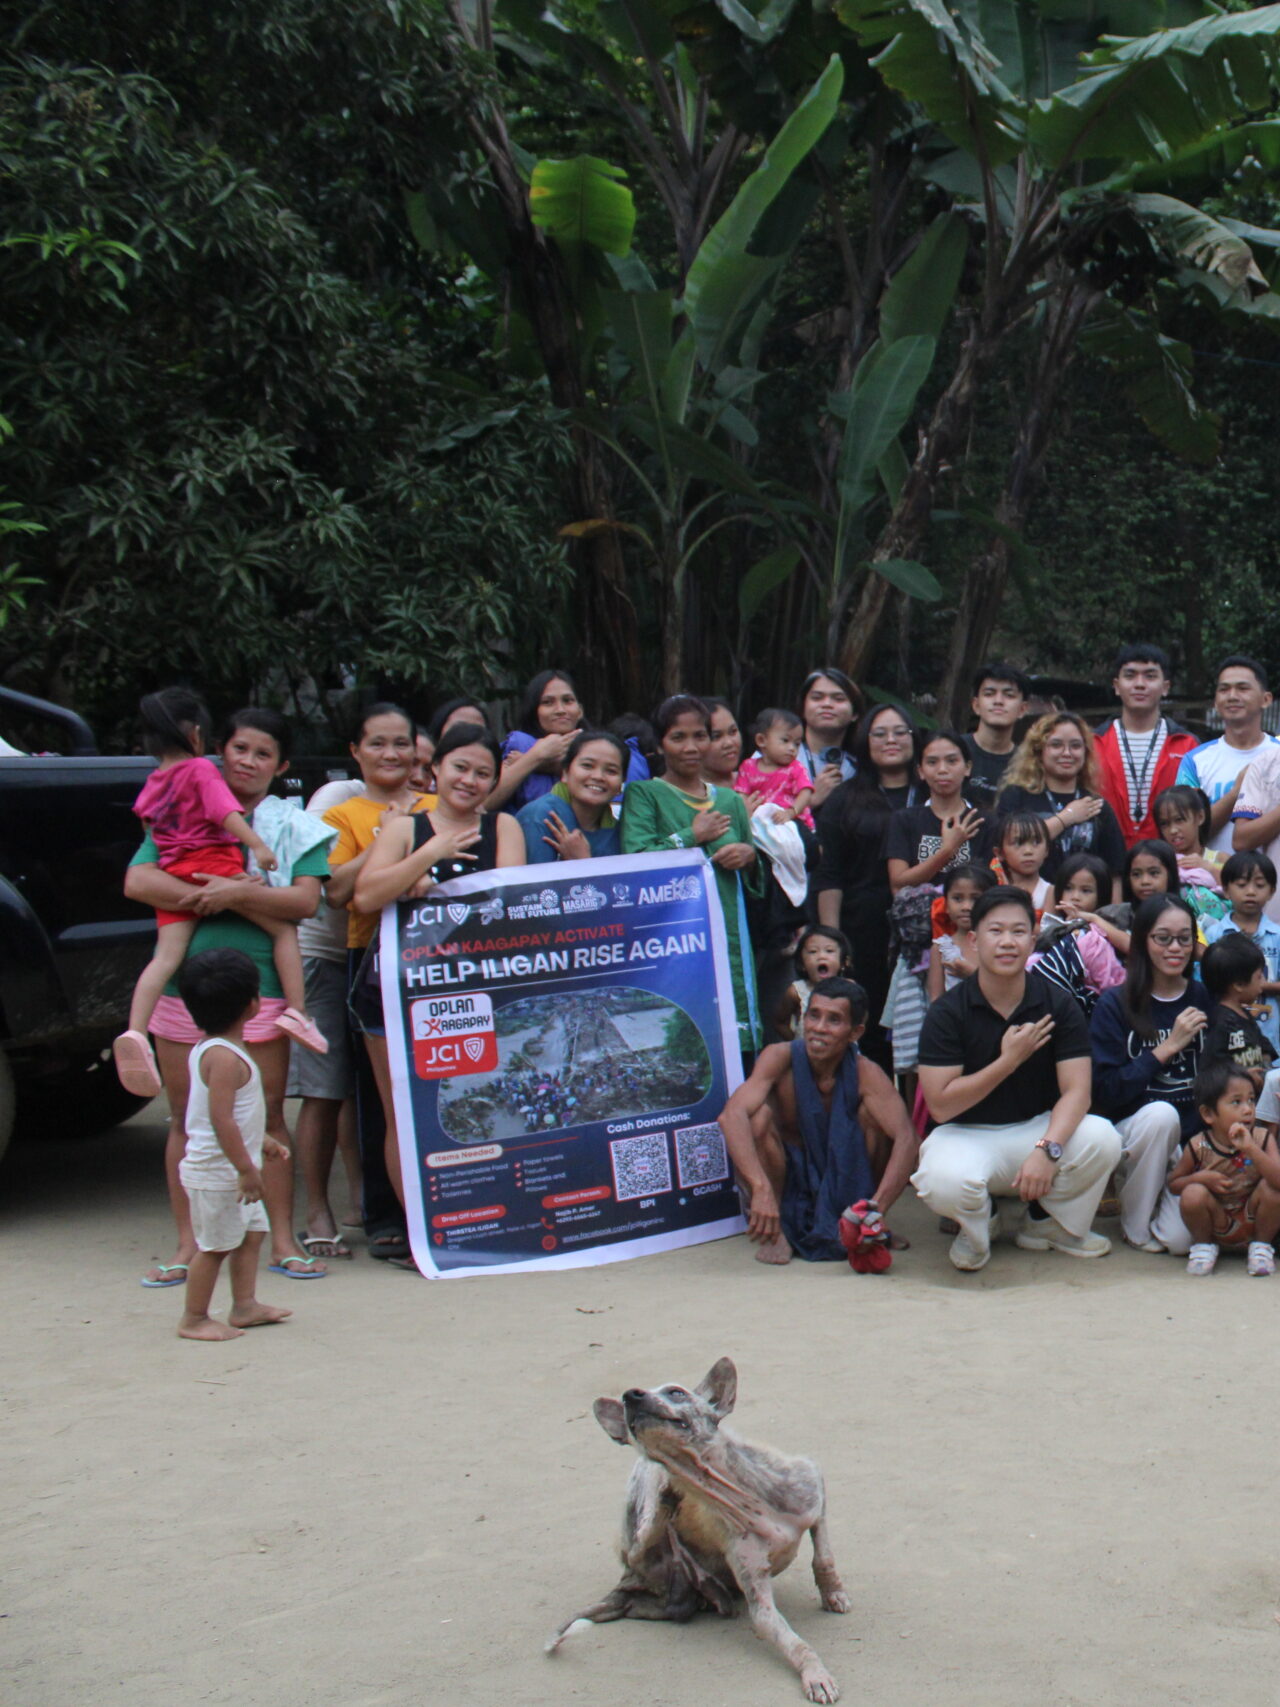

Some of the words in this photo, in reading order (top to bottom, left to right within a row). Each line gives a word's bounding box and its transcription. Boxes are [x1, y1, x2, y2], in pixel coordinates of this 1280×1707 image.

[919, 844, 971, 862] BS
[406, 904, 443, 928] JCI
[507, 903, 543, 914] SUSTAIN
[509, 911, 527, 920] THE
[528, 907, 561, 918] FUTURE
[401, 941, 458, 961] OPLAN
[461, 932, 551, 953] KAAGAPAY
[554, 923, 625, 943] ACTIVATE
[406, 960, 477, 988] HELP
[480, 950, 569, 979] ILIGAN
[574, 943, 625, 969] RISE
[629, 932, 707, 961] AGAIN
[429, 998, 475, 1017] OPLAN
[426, 1044, 461, 1065] JCI
[607, 1121, 634, 1134] Cash
[636, 1112, 691, 1129] Donations:
[461, 1147, 495, 1158] Needed
[693, 1184, 722, 1196] GCASH
[640, 1199, 656, 1209] BPI
